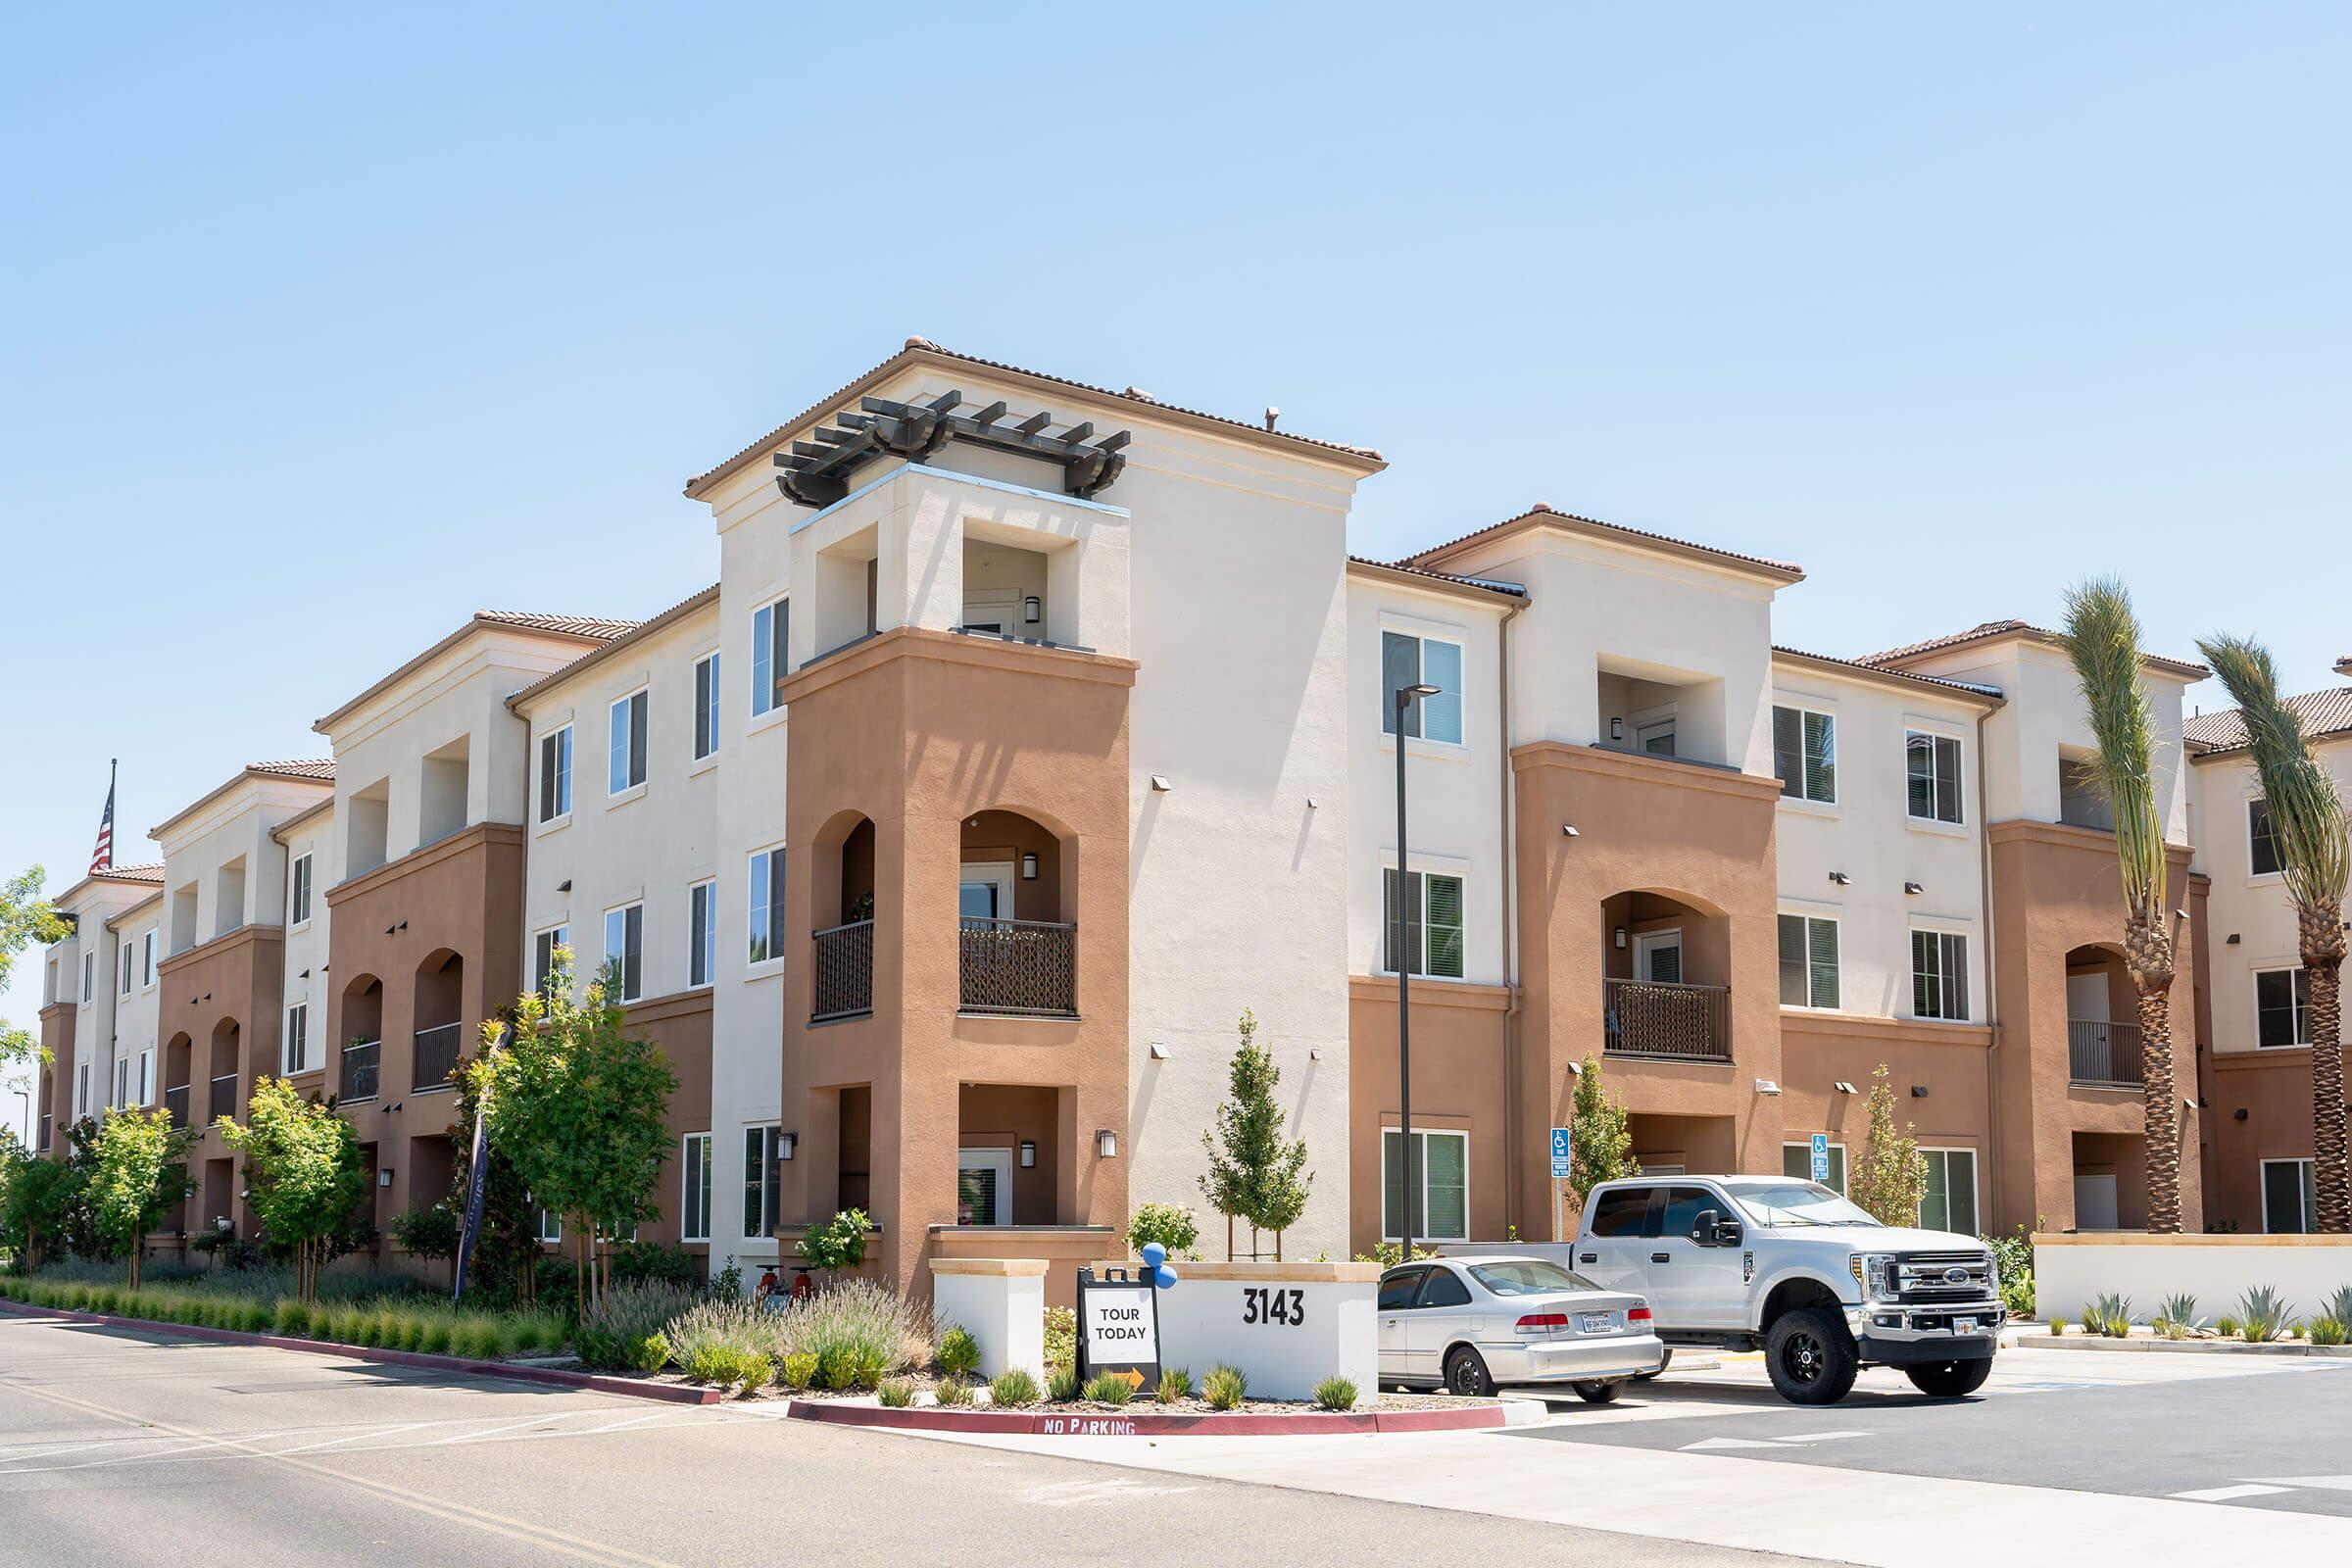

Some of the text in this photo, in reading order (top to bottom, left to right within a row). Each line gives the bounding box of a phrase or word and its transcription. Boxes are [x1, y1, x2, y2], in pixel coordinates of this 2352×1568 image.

[1100, 1308, 1140, 1321] TOUR
[1243, 1288, 1304, 1326] 3143
[1095, 1327, 1147, 1340] TODAY
[1044, 1418, 1136, 1436] NO PARKING
